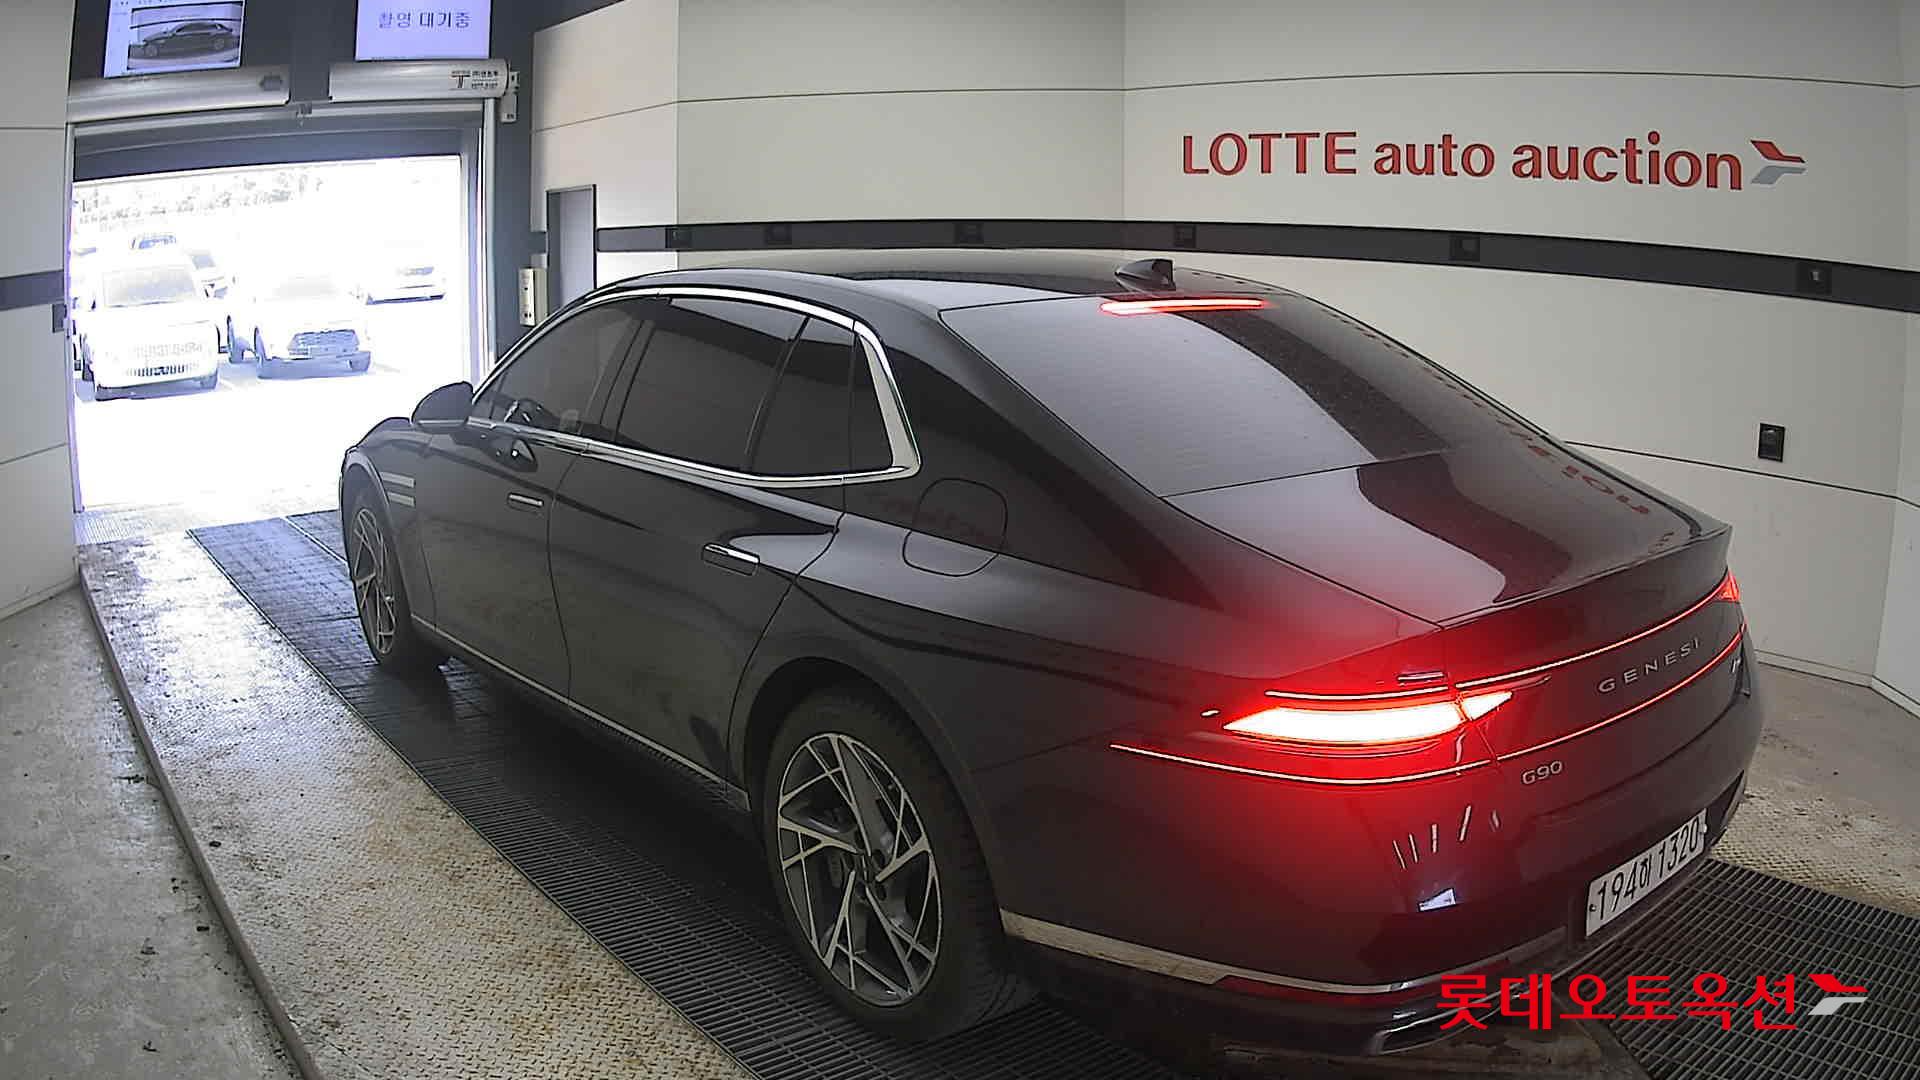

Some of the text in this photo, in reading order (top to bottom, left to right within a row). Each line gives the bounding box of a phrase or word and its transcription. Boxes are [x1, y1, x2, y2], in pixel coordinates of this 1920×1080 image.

[419, 11, 472, 28] 대기중
[1183, 131, 1742, 190] LOTTE auto auction
[1521, 760, 1563, 784] G90
[1659, 815, 1699, 878] 1320
